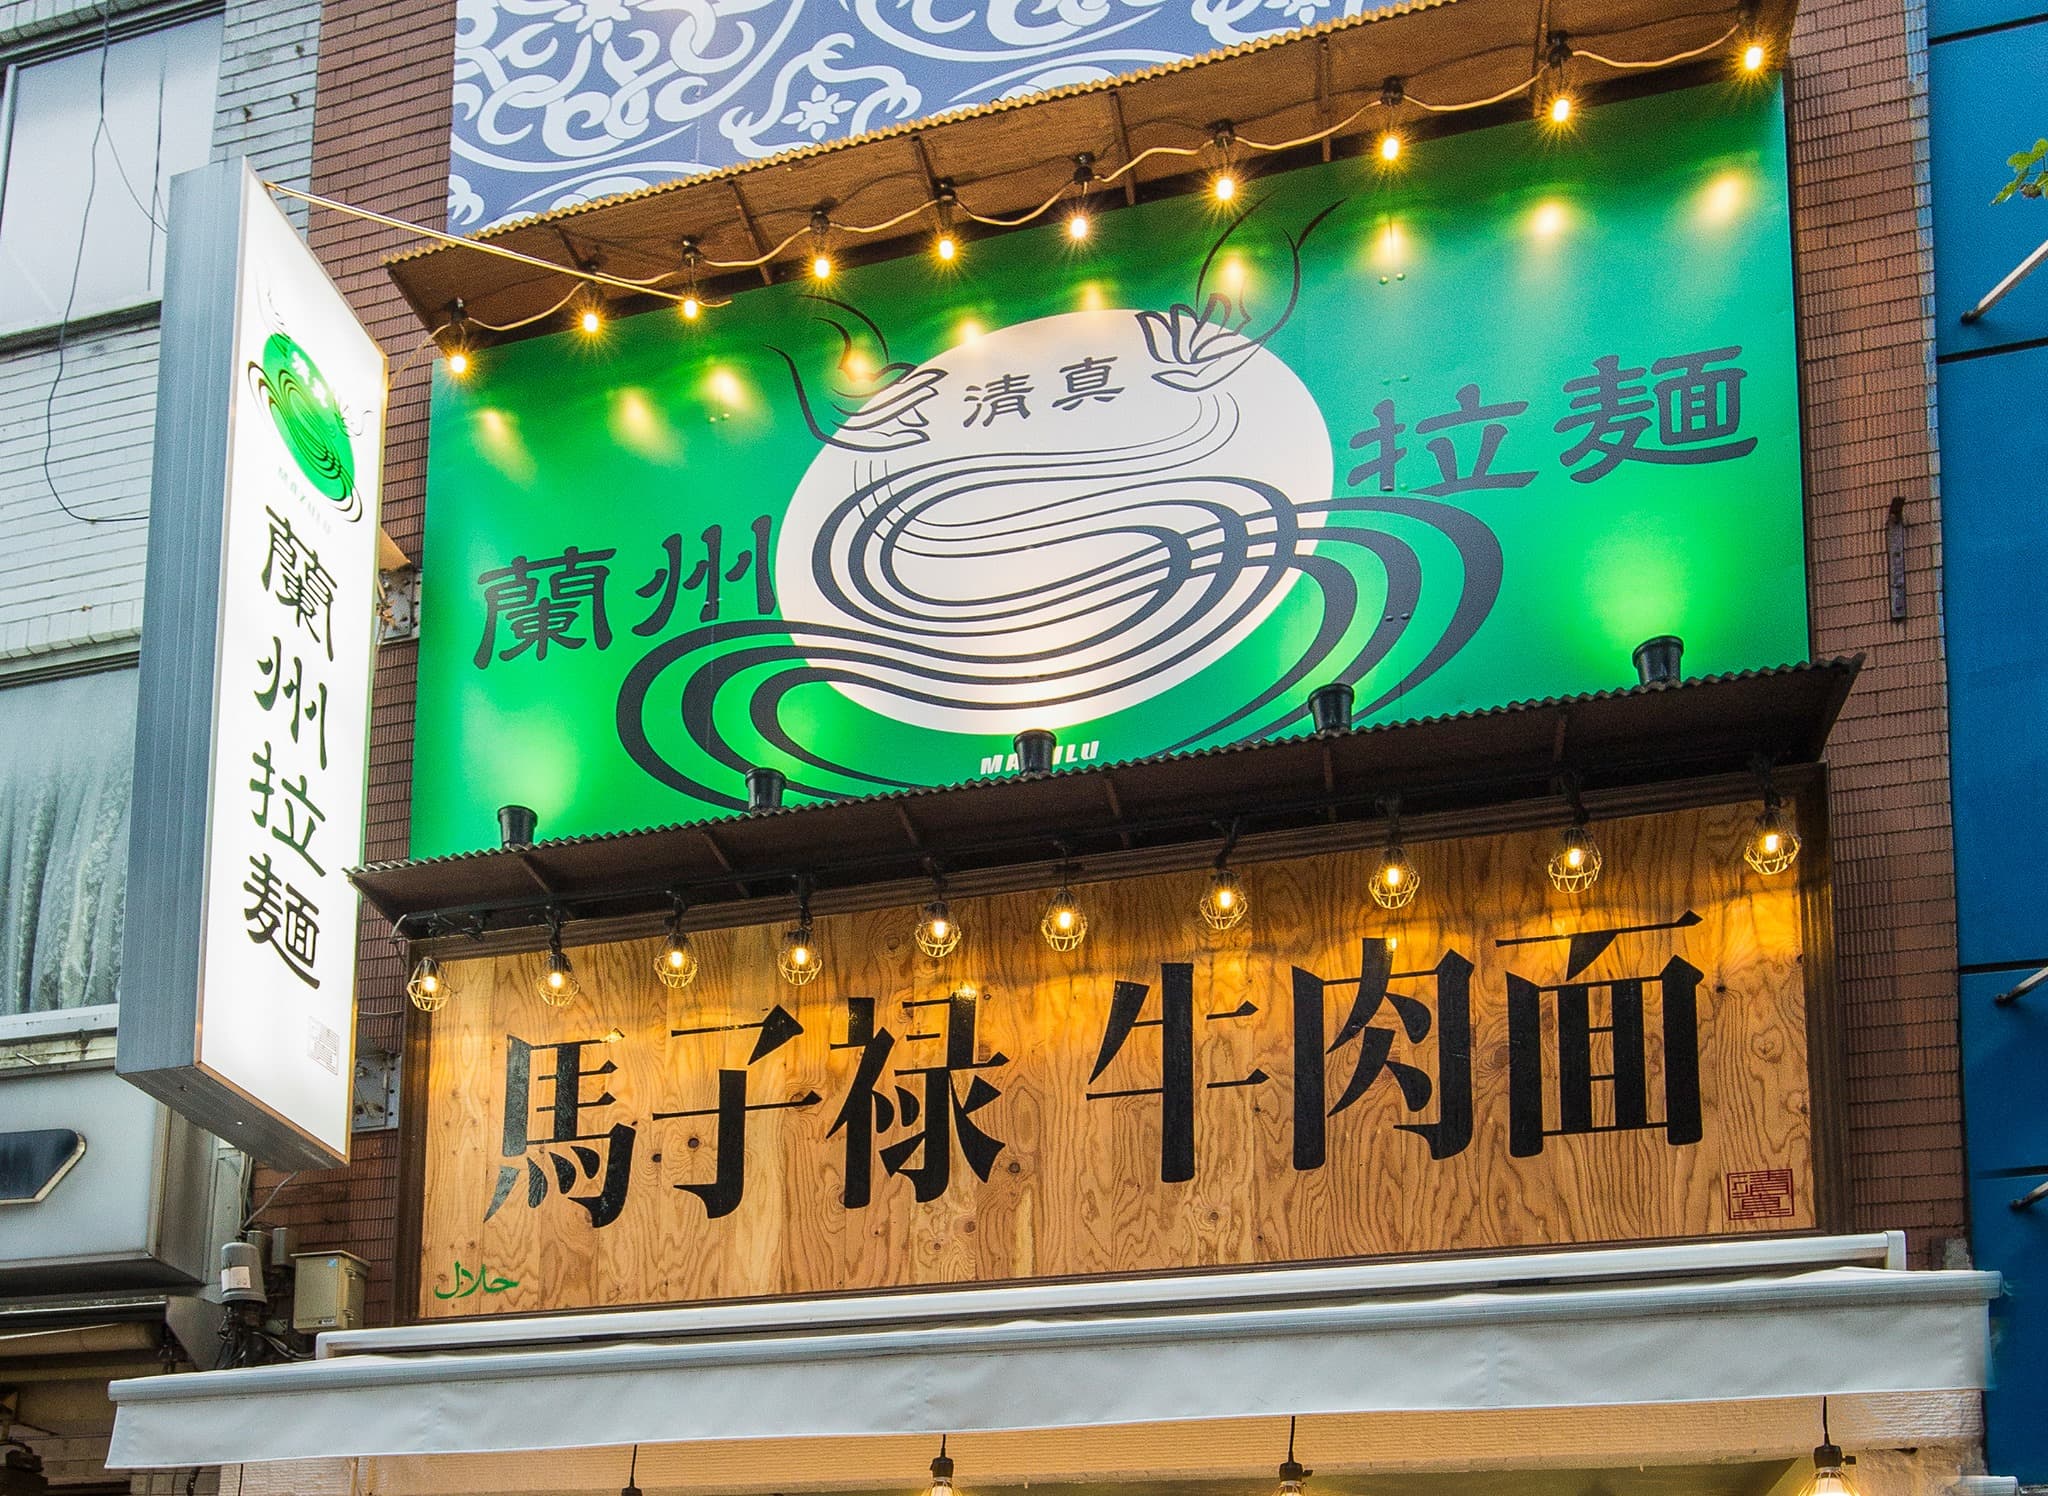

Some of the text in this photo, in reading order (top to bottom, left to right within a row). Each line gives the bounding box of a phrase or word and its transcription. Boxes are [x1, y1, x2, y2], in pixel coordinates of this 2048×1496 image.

[962, 356, 1126, 428] 清真
[473, 514, 777, 670] 蘭州
[980, 740, 1100, 775] MALU
[1086, 909, 1705, 1184] 牛肉面
[433, 1260, 520, 1300] حلال
